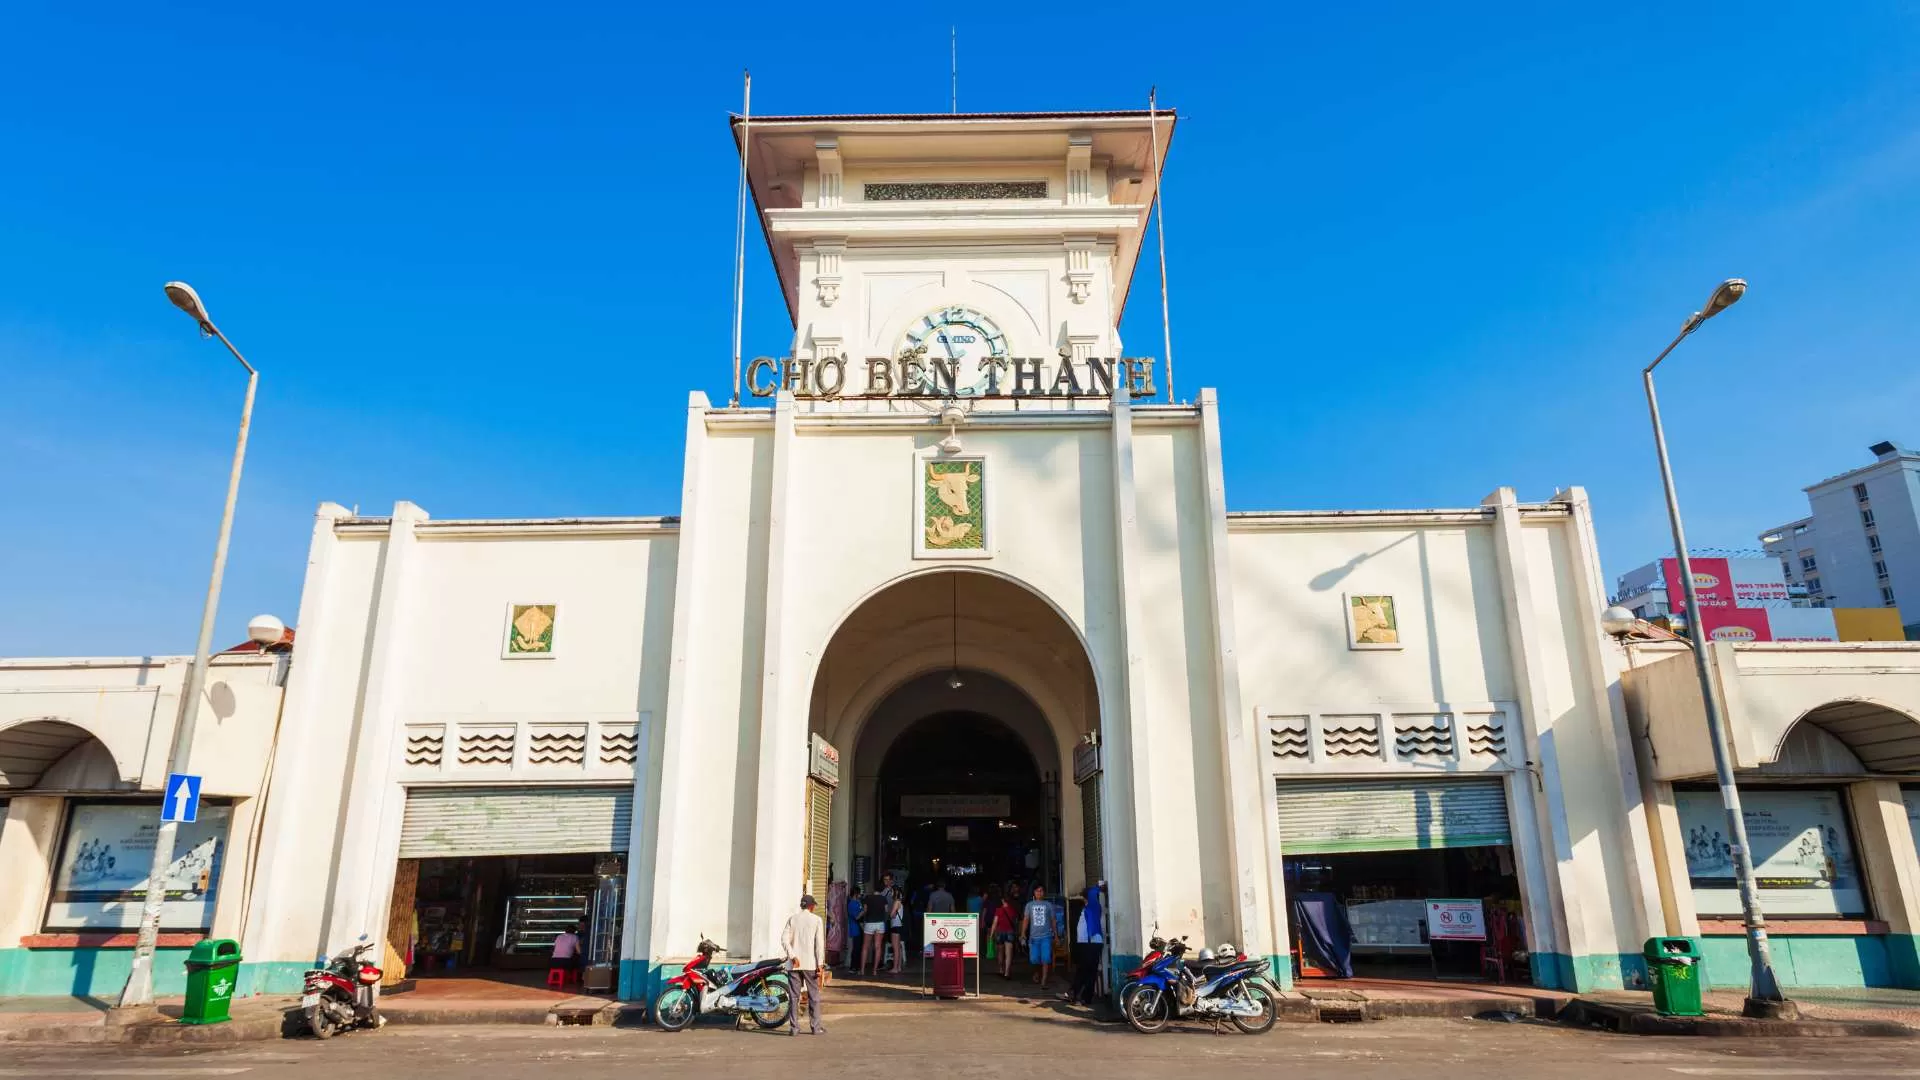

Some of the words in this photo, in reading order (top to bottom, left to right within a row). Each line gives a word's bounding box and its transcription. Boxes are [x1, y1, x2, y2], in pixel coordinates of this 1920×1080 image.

[746, 352, 848, 401] CHỢ
[865, 344, 961, 396] BẾN
[978, 347, 1157, 397] THÀNH
